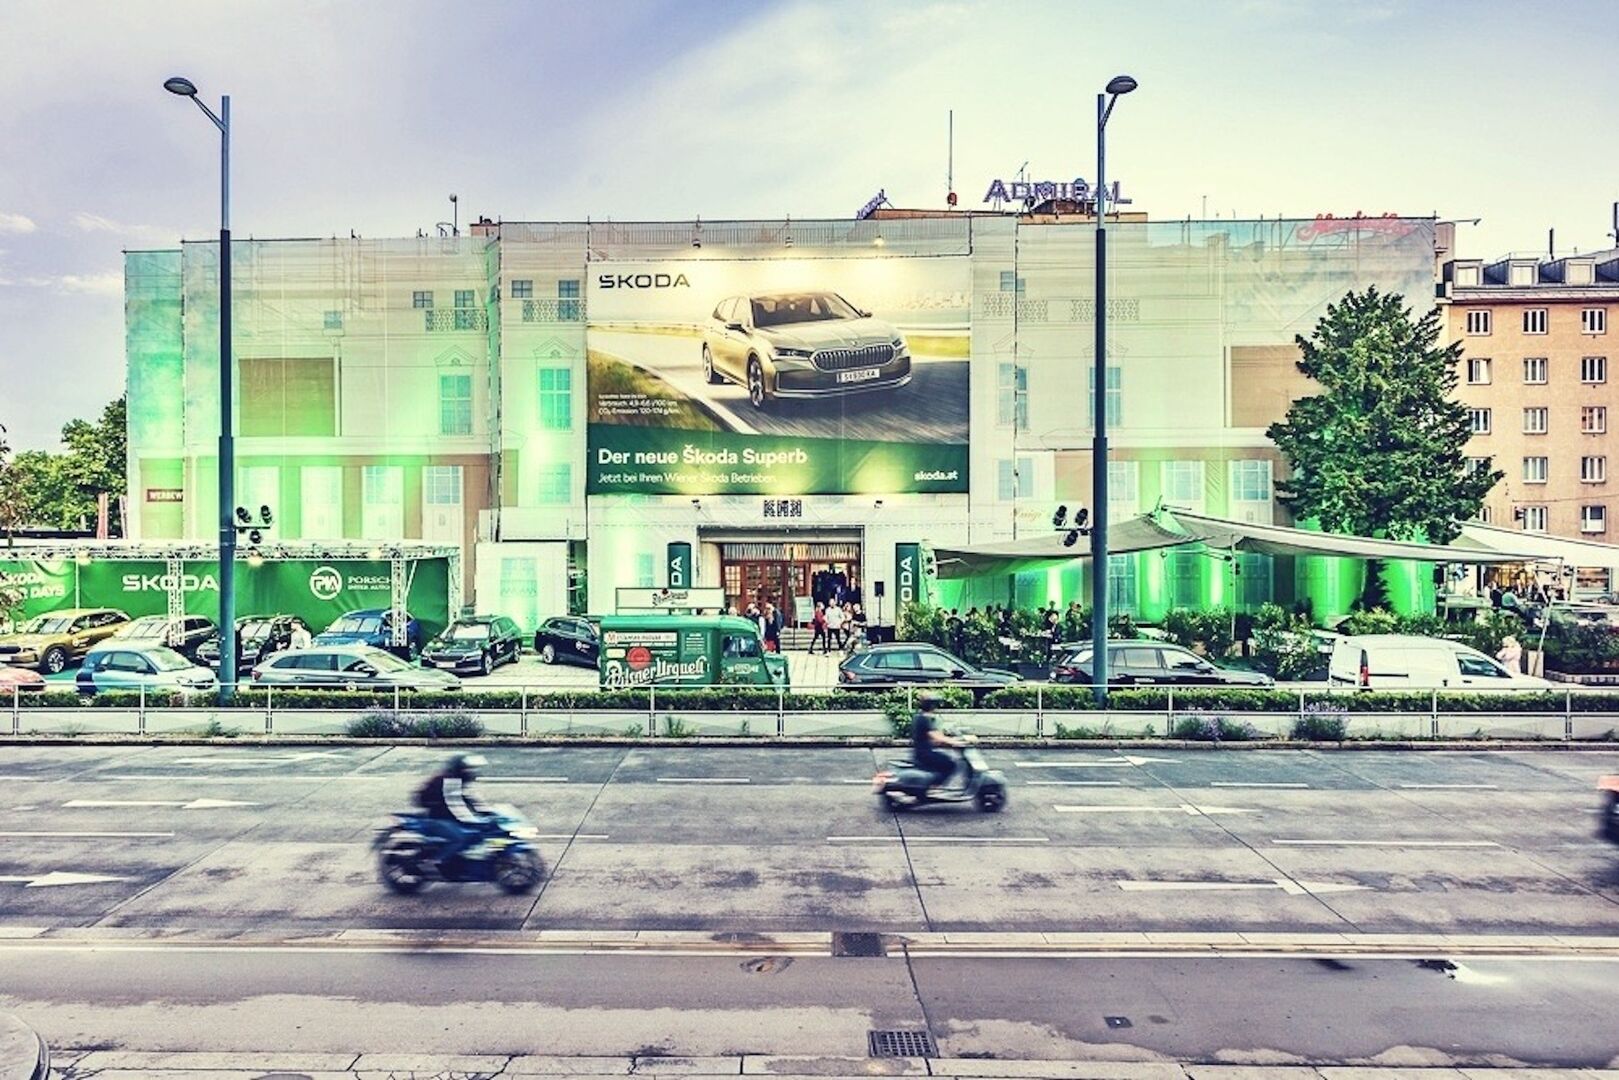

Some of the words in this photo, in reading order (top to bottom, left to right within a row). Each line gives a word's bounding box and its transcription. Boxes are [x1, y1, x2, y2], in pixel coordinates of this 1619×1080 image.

[982, 179, 1132, 205] ADMIRAL
[598, 448, 630, 464] Der
[635, 450, 678, 464] neue
[683, 444, 738, 464] Škoda
[742, 448, 808, 468] Superb
[598, 472, 622, 484] Jetzt
[623, 472, 638, 483] bei
[639, 472, 663, 483] Ihren
[664, 472, 699, 483] Wiener
[914, 470, 958, 481] skoda.at
[605, 659, 657, 690] Pilsner
[656, 656, 707, 684] Urquell
